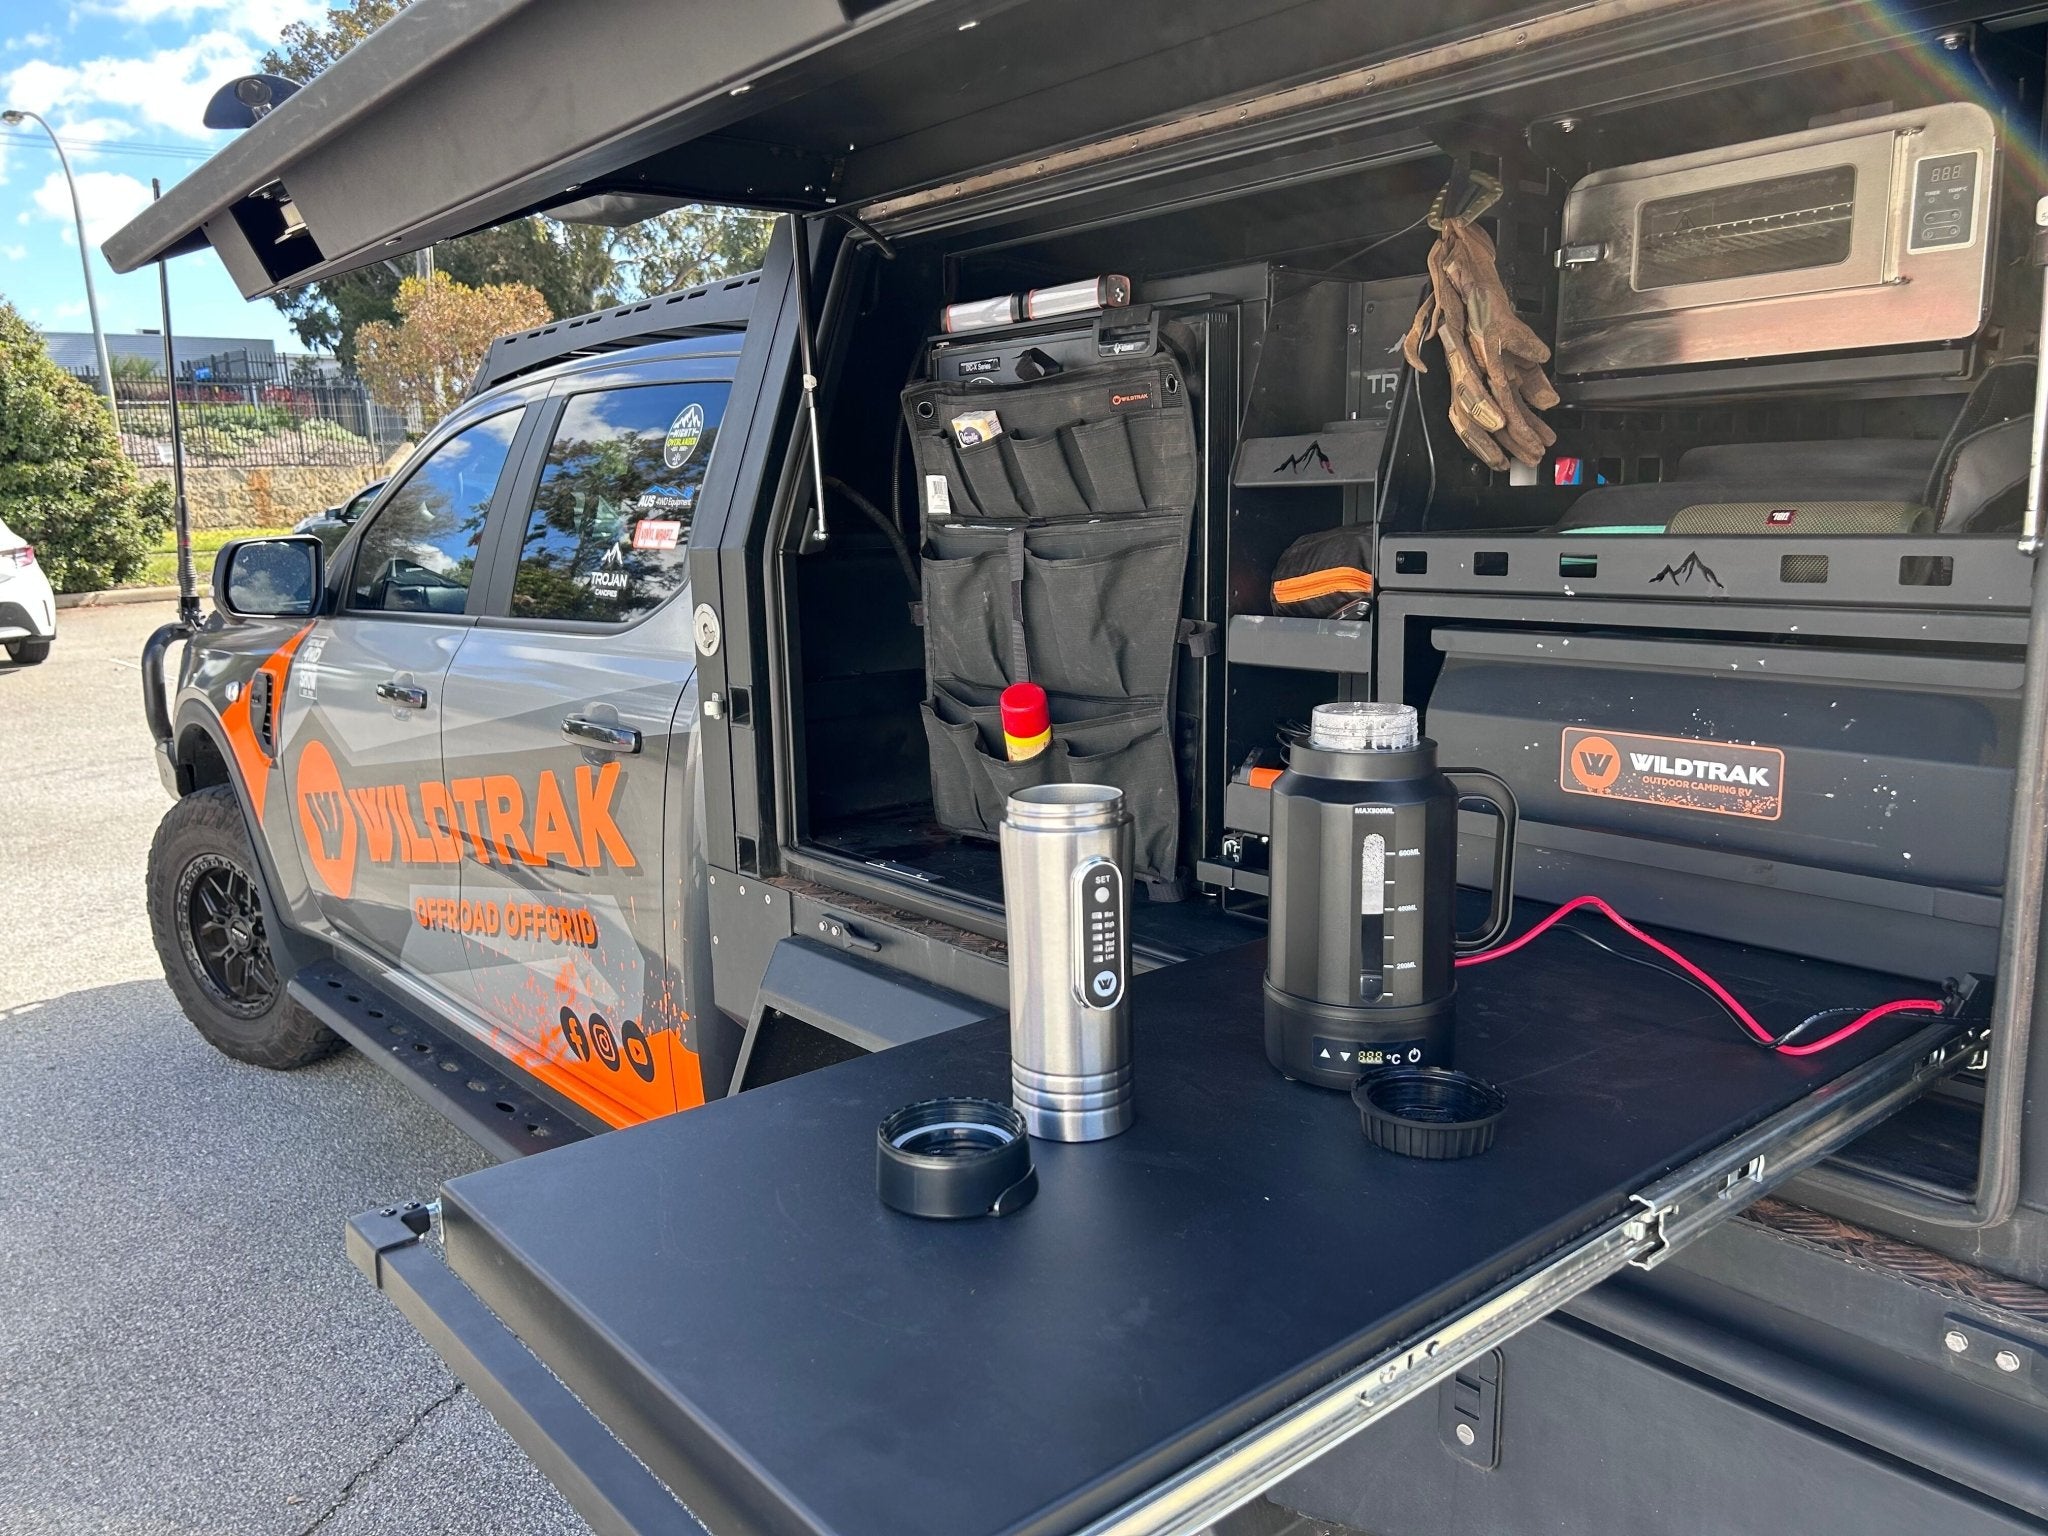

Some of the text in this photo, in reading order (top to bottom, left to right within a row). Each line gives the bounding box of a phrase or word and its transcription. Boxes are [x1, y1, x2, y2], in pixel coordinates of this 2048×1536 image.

[638, 495, 656, 508] AUS
[668, 497, 692, 508] Equipment
[591, 571, 628, 588] TROJAN
[1630, 752, 1770, 787] WILDTRAK
[1642, 775, 1753, 798] OUTDOOR CAMPING RV
[348, 762, 637, 868] WILDTRAK
[1095, 875, 1111, 884] SET
[416, 895, 598, 949] OFFROAD OFFGRID
[1396, 961, 1417, 970] 200ML
